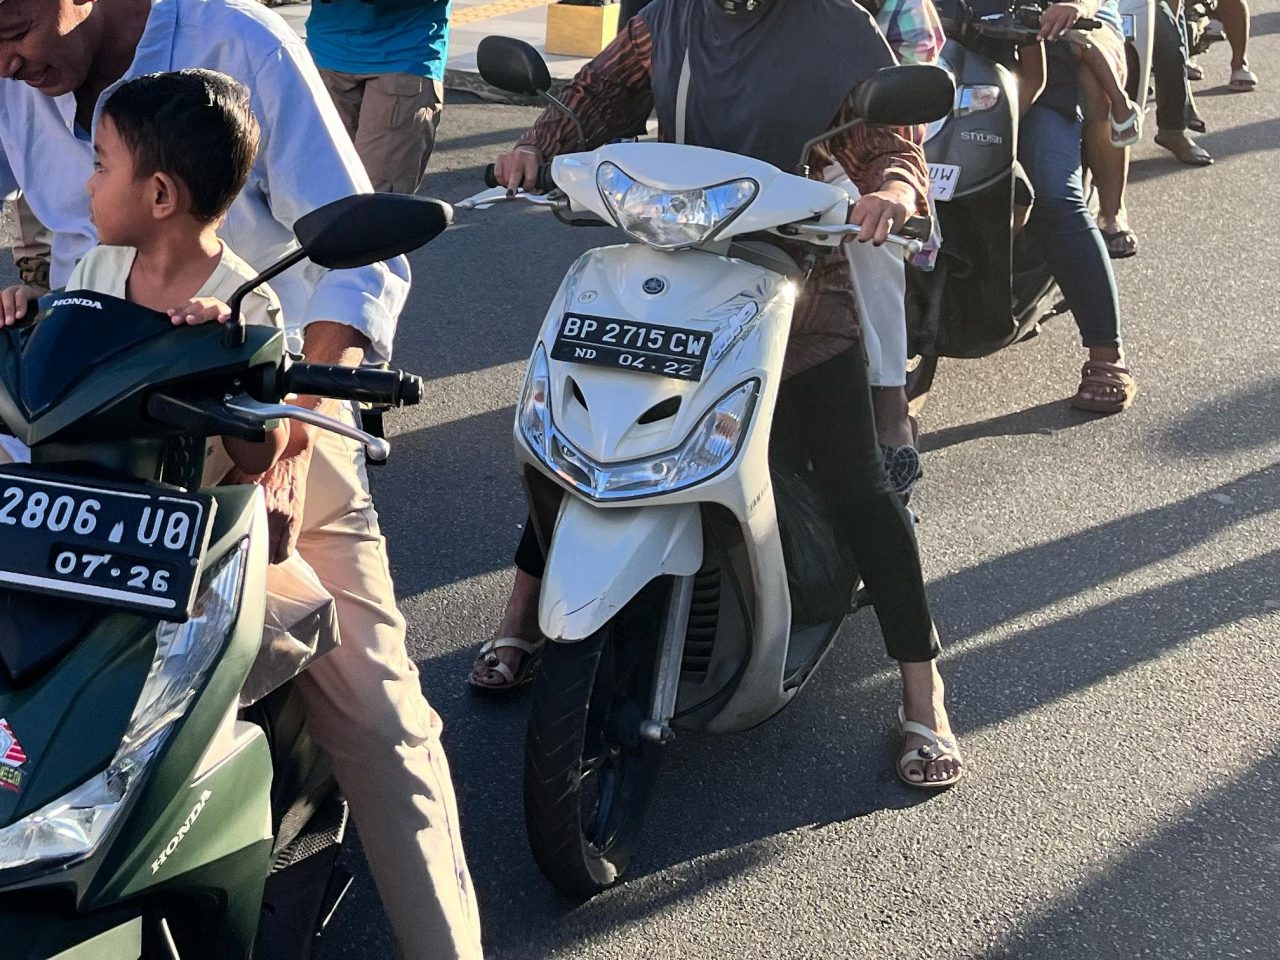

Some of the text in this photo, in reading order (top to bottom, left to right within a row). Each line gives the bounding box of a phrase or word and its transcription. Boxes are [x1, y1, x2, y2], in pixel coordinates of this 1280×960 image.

[52, 297, 103, 310] HONDA
[563, 317, 706, 356] BP 2715 CW
[574, 347, 597, 359] ND
[150, 789, 212, 875] HONDA
